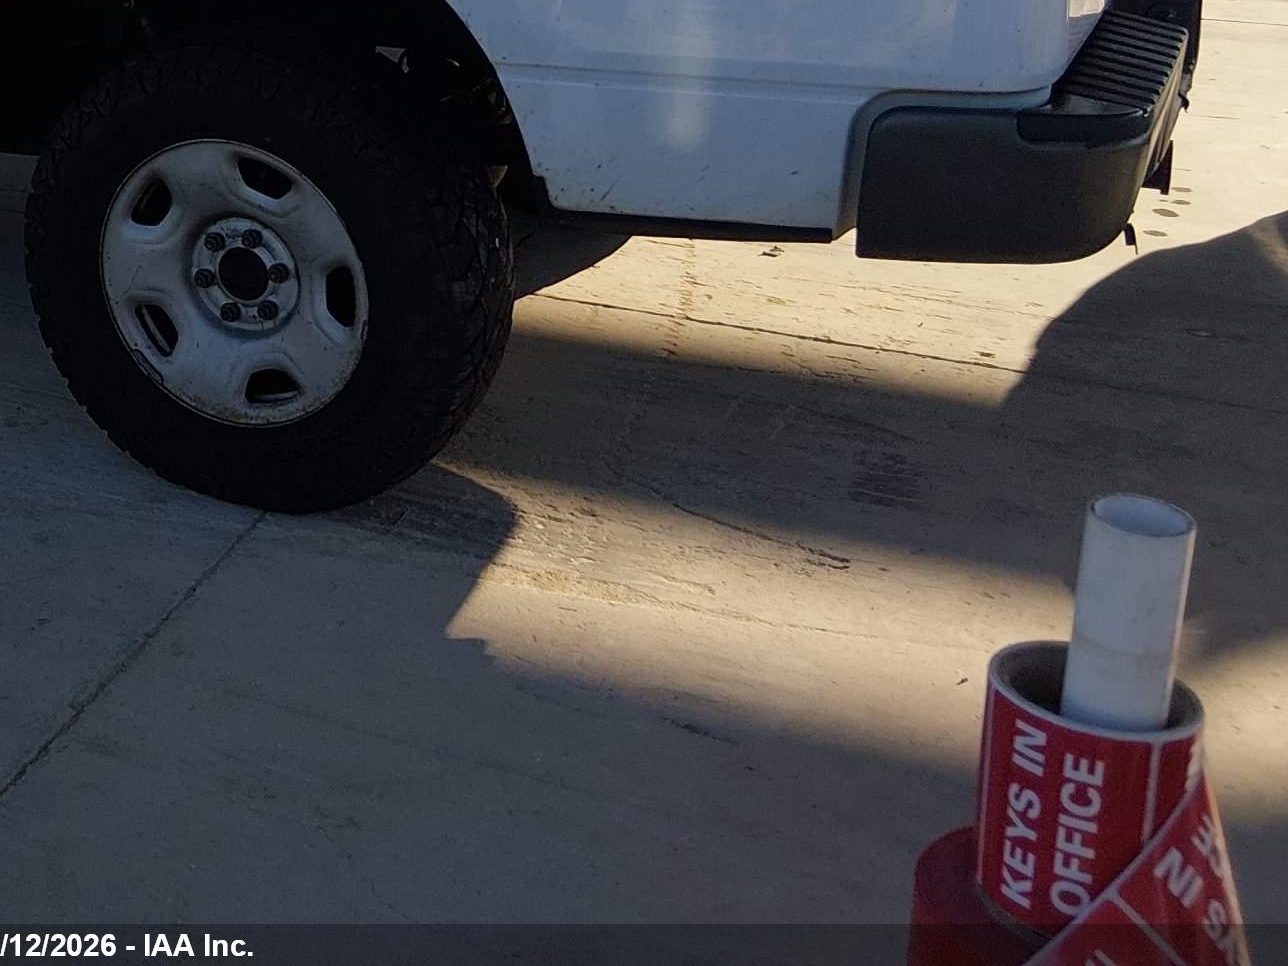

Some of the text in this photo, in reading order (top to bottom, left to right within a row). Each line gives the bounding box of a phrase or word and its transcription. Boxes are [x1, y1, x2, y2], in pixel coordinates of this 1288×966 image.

[1000, 719, 1048, 909] KEYS IN
[1049, 752, 1105, 918] OFFICE
